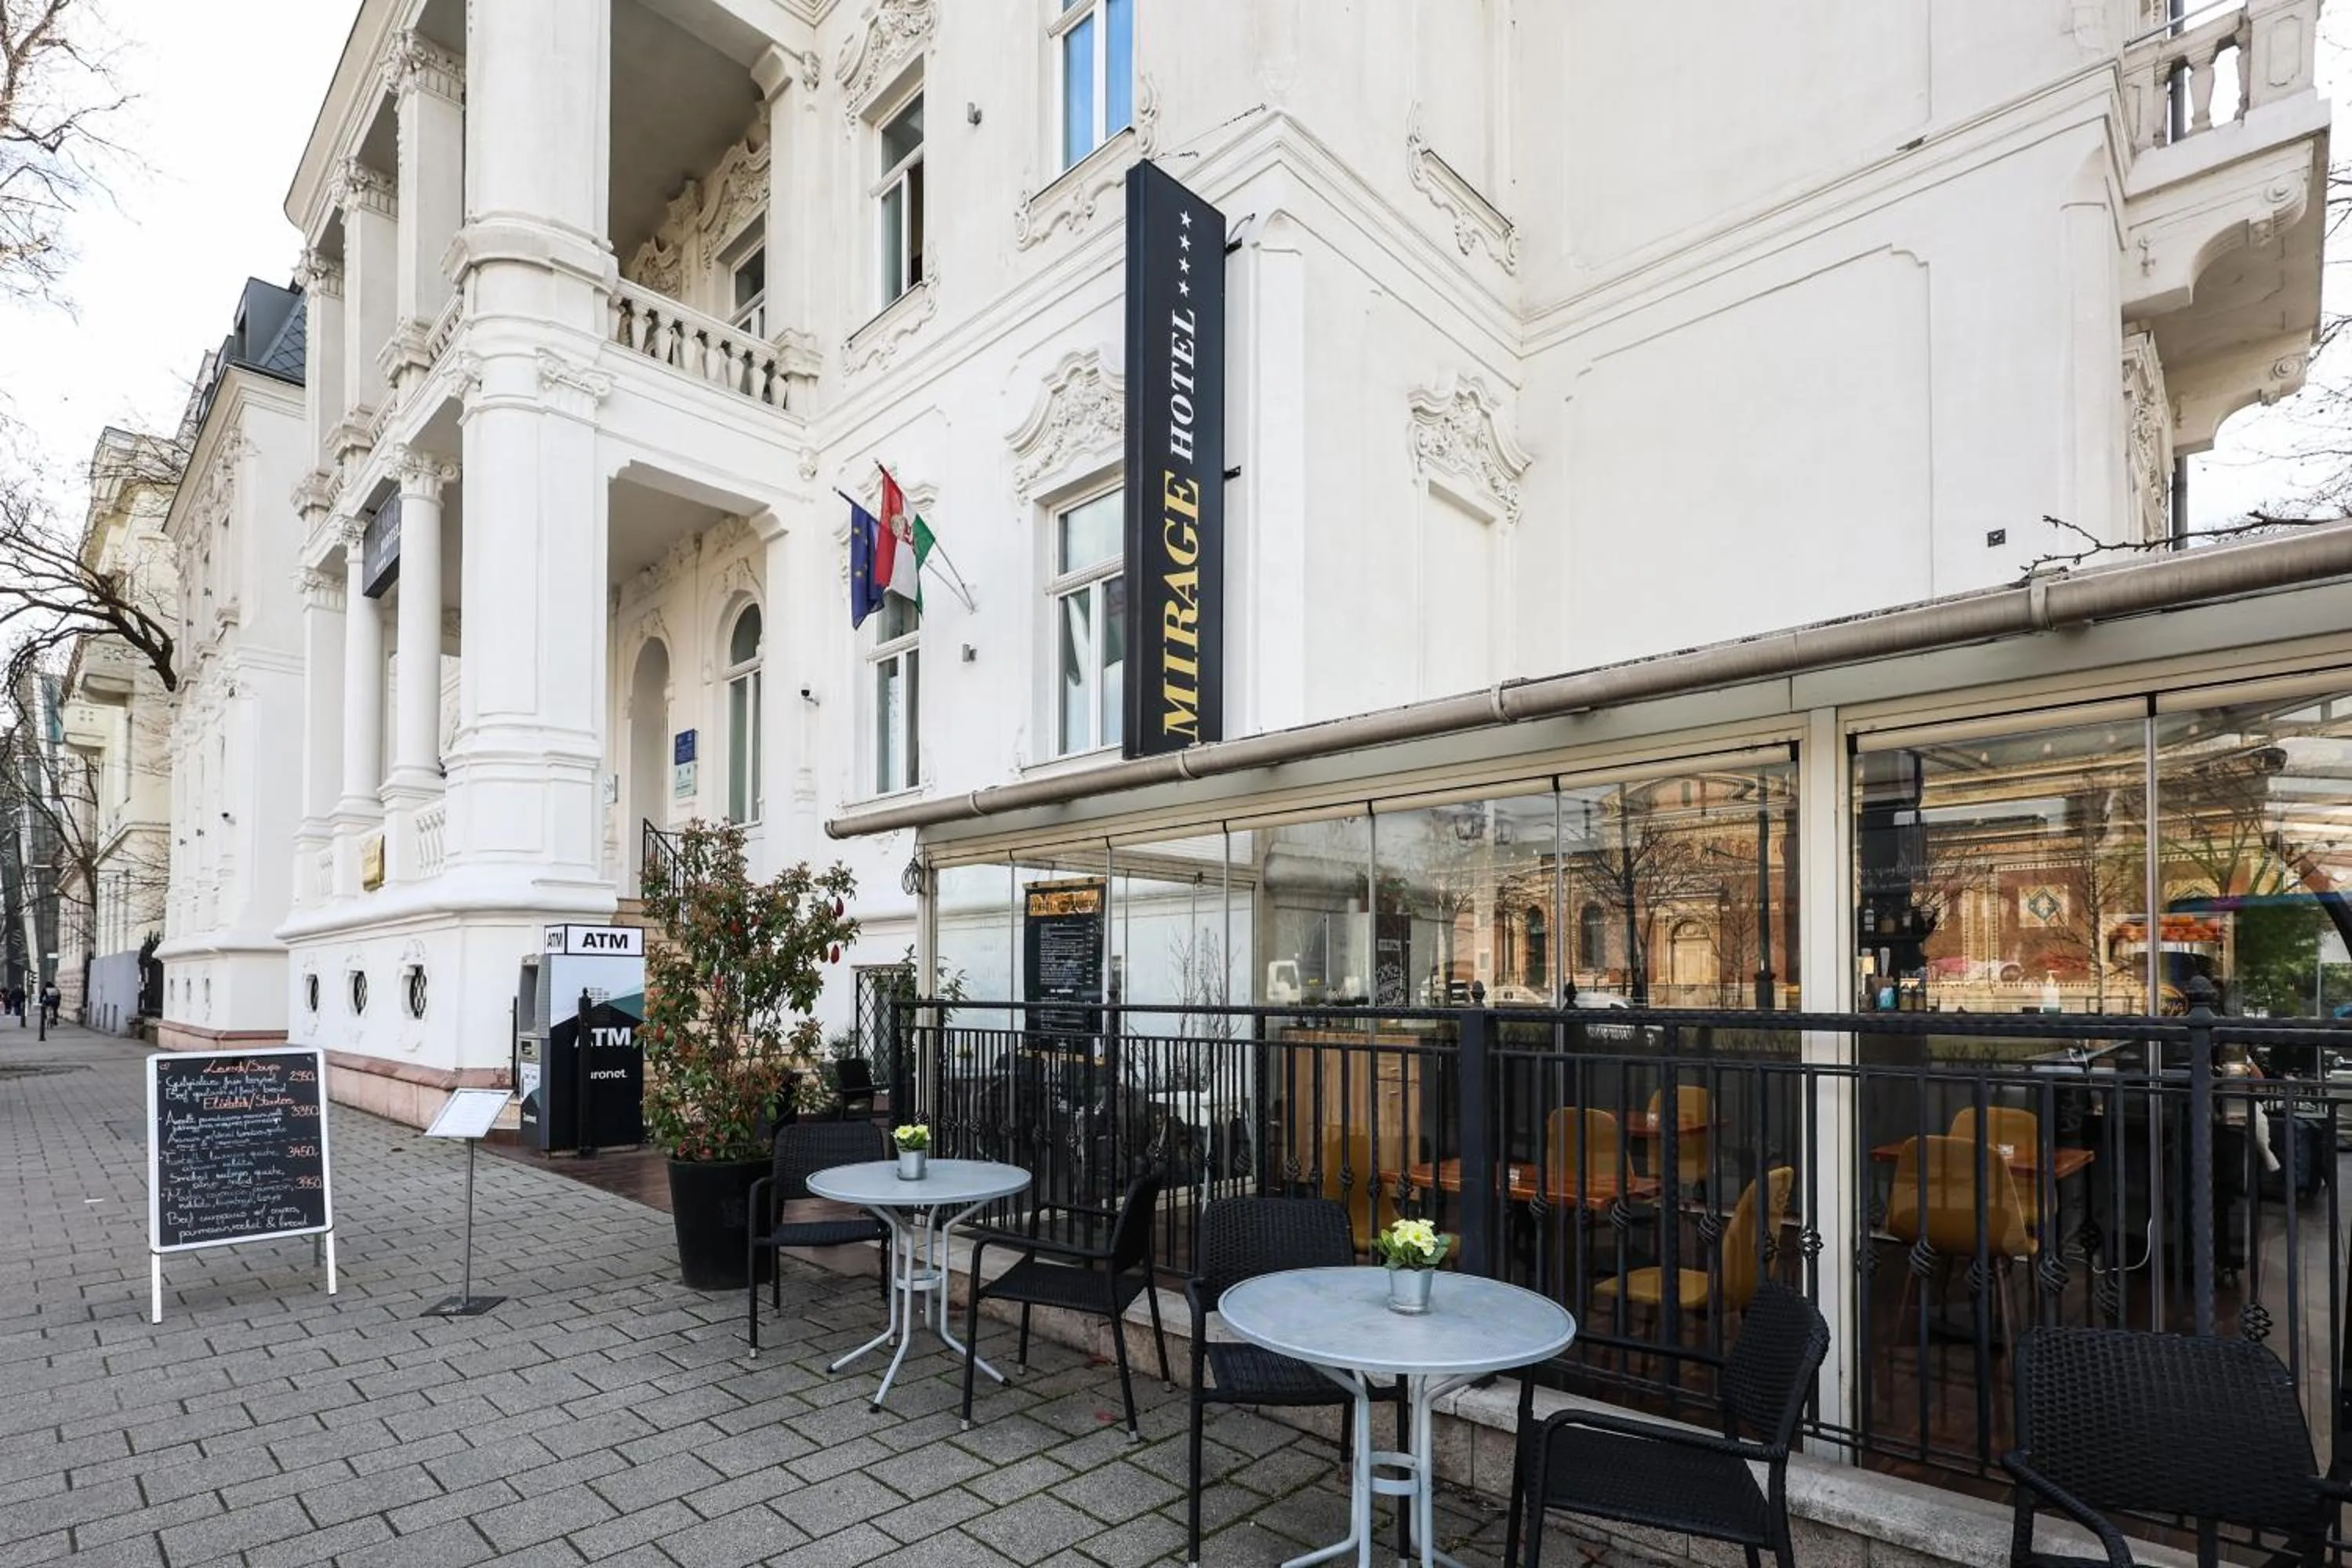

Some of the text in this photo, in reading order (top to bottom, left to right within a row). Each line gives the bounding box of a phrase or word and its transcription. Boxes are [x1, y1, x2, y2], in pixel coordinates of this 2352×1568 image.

[1163, 310, 1199, 742] MIRAGE HOTEL
[547, 933, 563, 948] ATM
[582, 932, 629, 949] ATM
